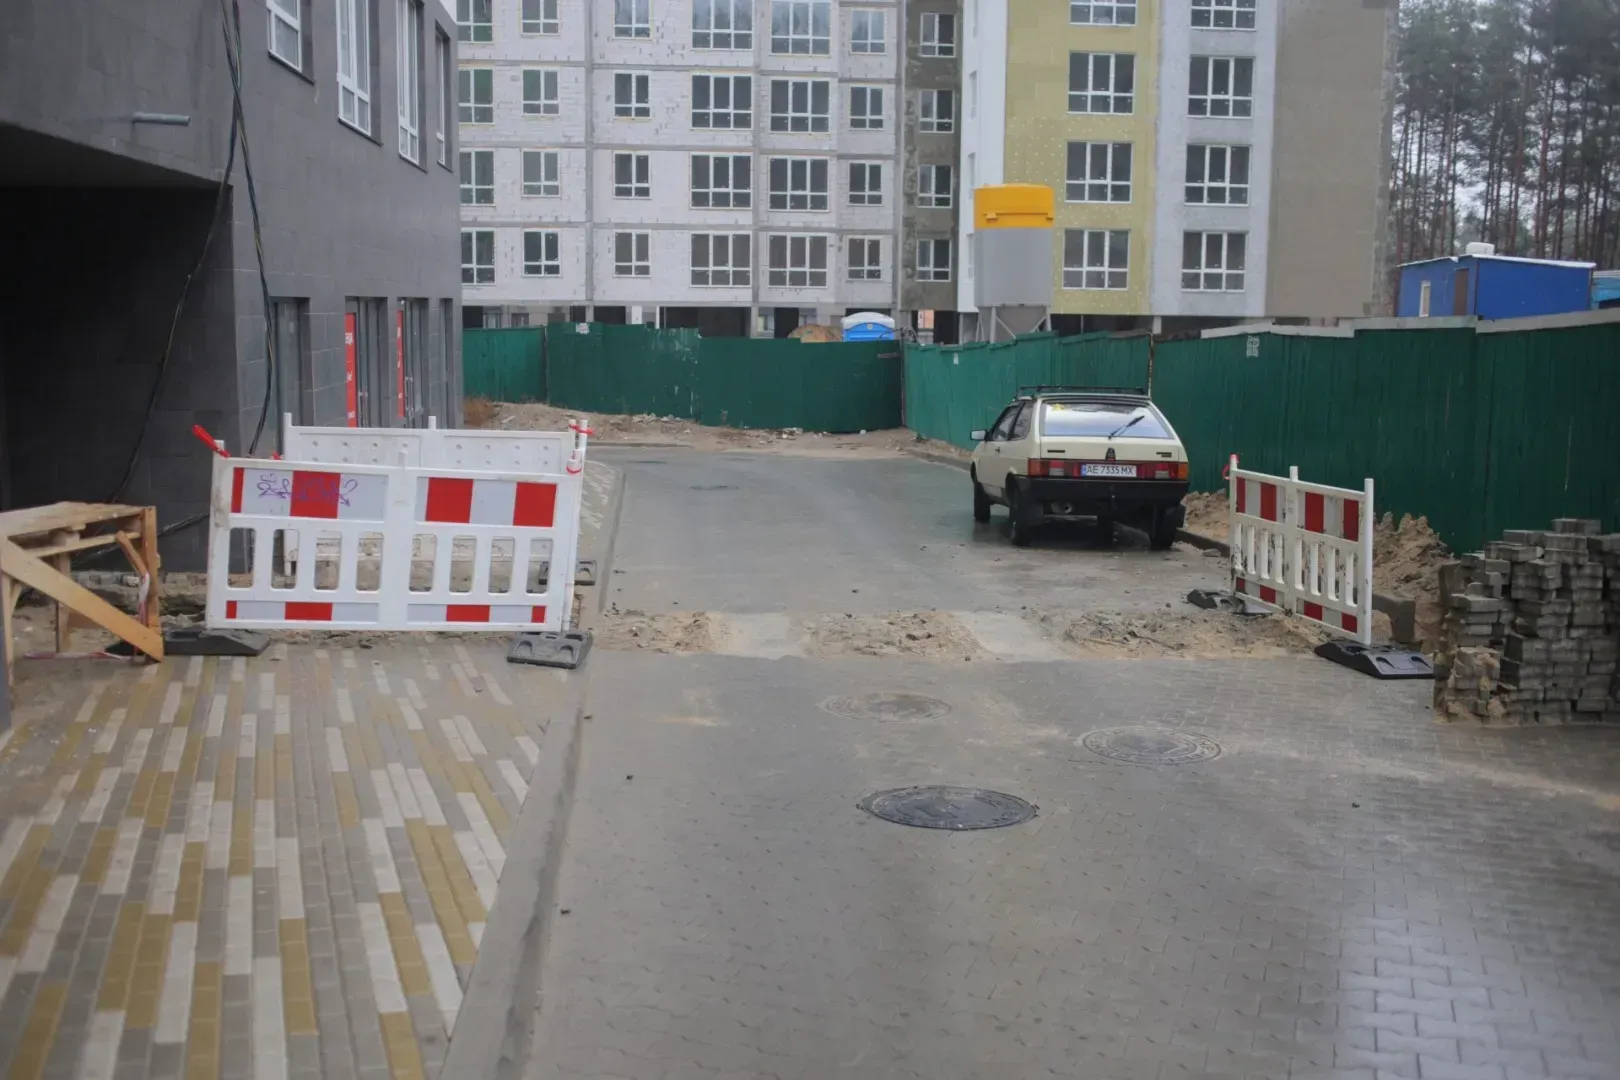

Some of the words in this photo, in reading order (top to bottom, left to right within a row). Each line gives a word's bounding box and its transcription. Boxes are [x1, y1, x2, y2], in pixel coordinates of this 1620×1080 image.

[1087, 465, 1099, 475] AE
[1100, 465, 1120, 475] 7335
[1121, 466, 1134, 475] MX
